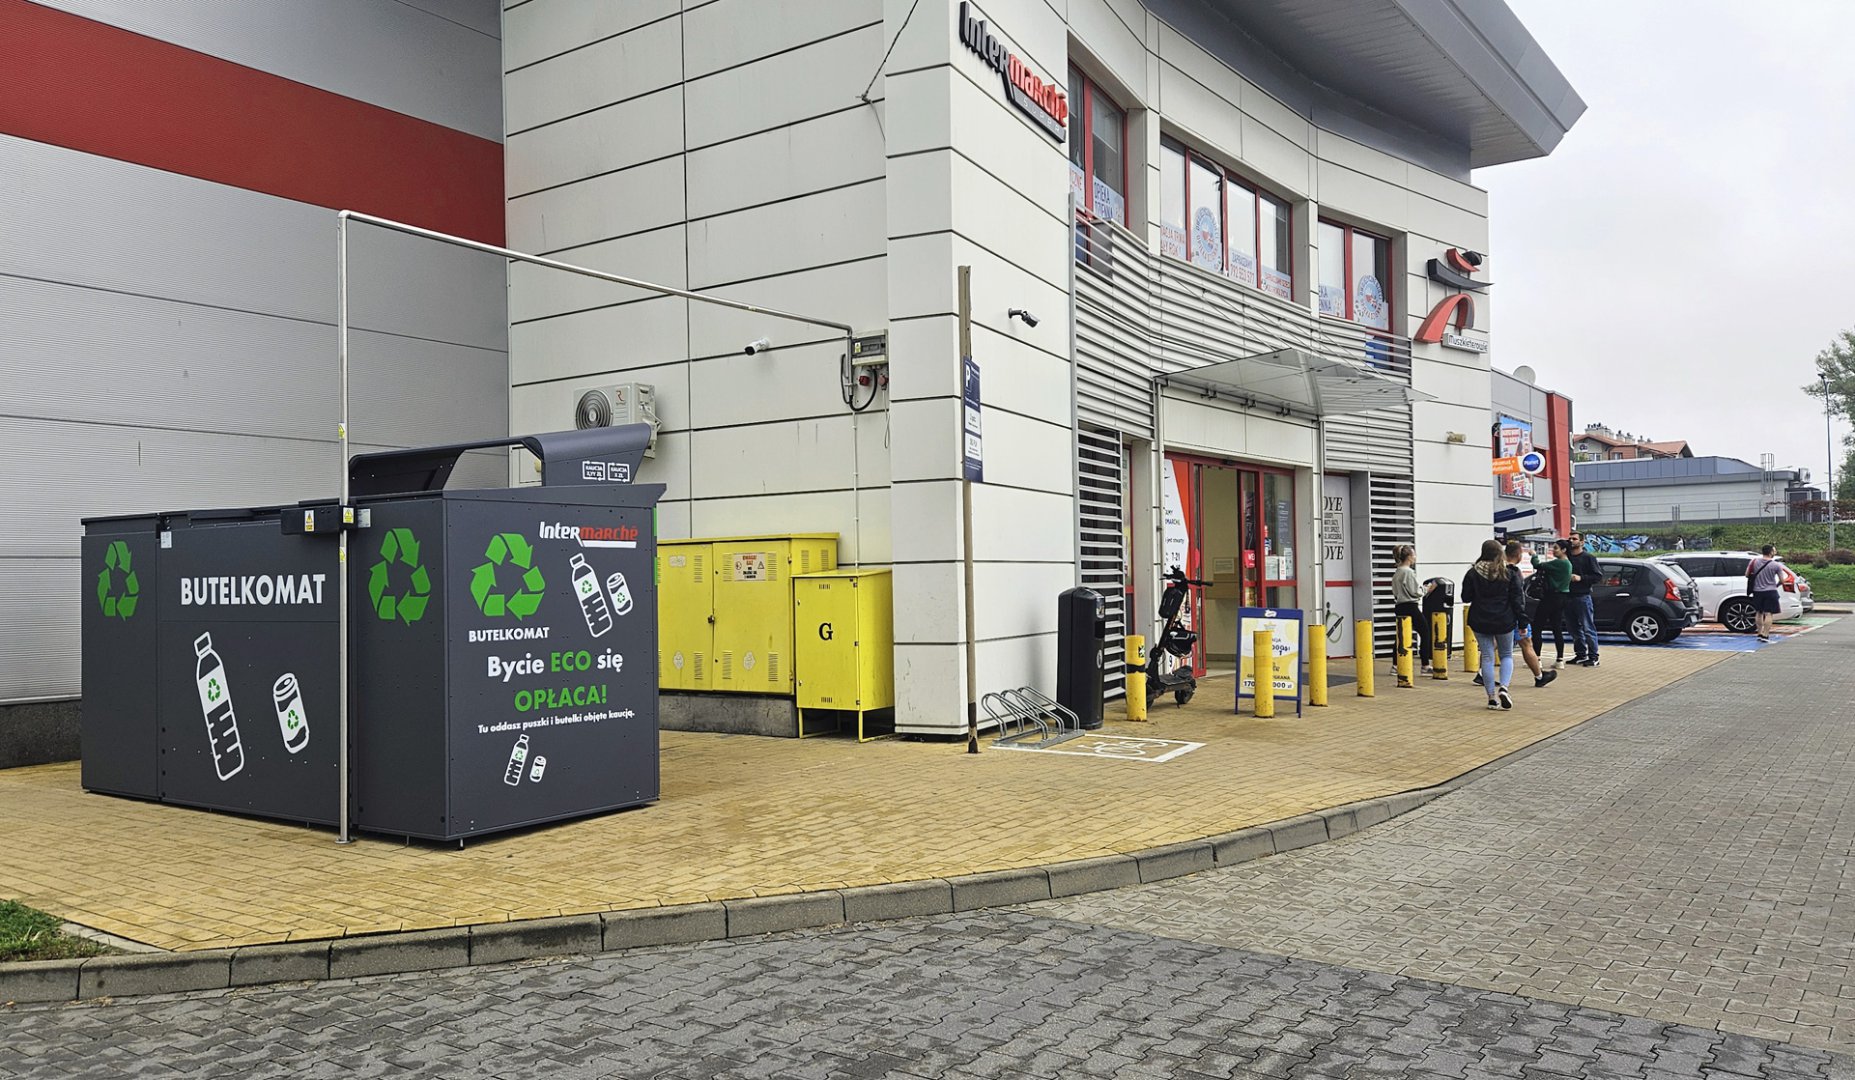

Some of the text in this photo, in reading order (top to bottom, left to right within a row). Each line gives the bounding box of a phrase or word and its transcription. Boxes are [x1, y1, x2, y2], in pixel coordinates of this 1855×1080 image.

[539, 521, 638, 542] Intermarché
[180, 573, 326, 606] BUTELKOMAT
[468, 627, 550, 643] BUTELKOMAT
[818, 623, 834, 641] G
[487, 648, 623, 683] Bycie ECO się
[514, 684, 607, 713] OPŁACA!
[478, 724, 489, 734] Tu
[490, 721, 521, 733] oddasz
[522, 717, 549, 731] puszki
[550, 716, 554, 726] i
[555, 713, 582, 725] butelki
[583, 710, 607, 724] objęte
